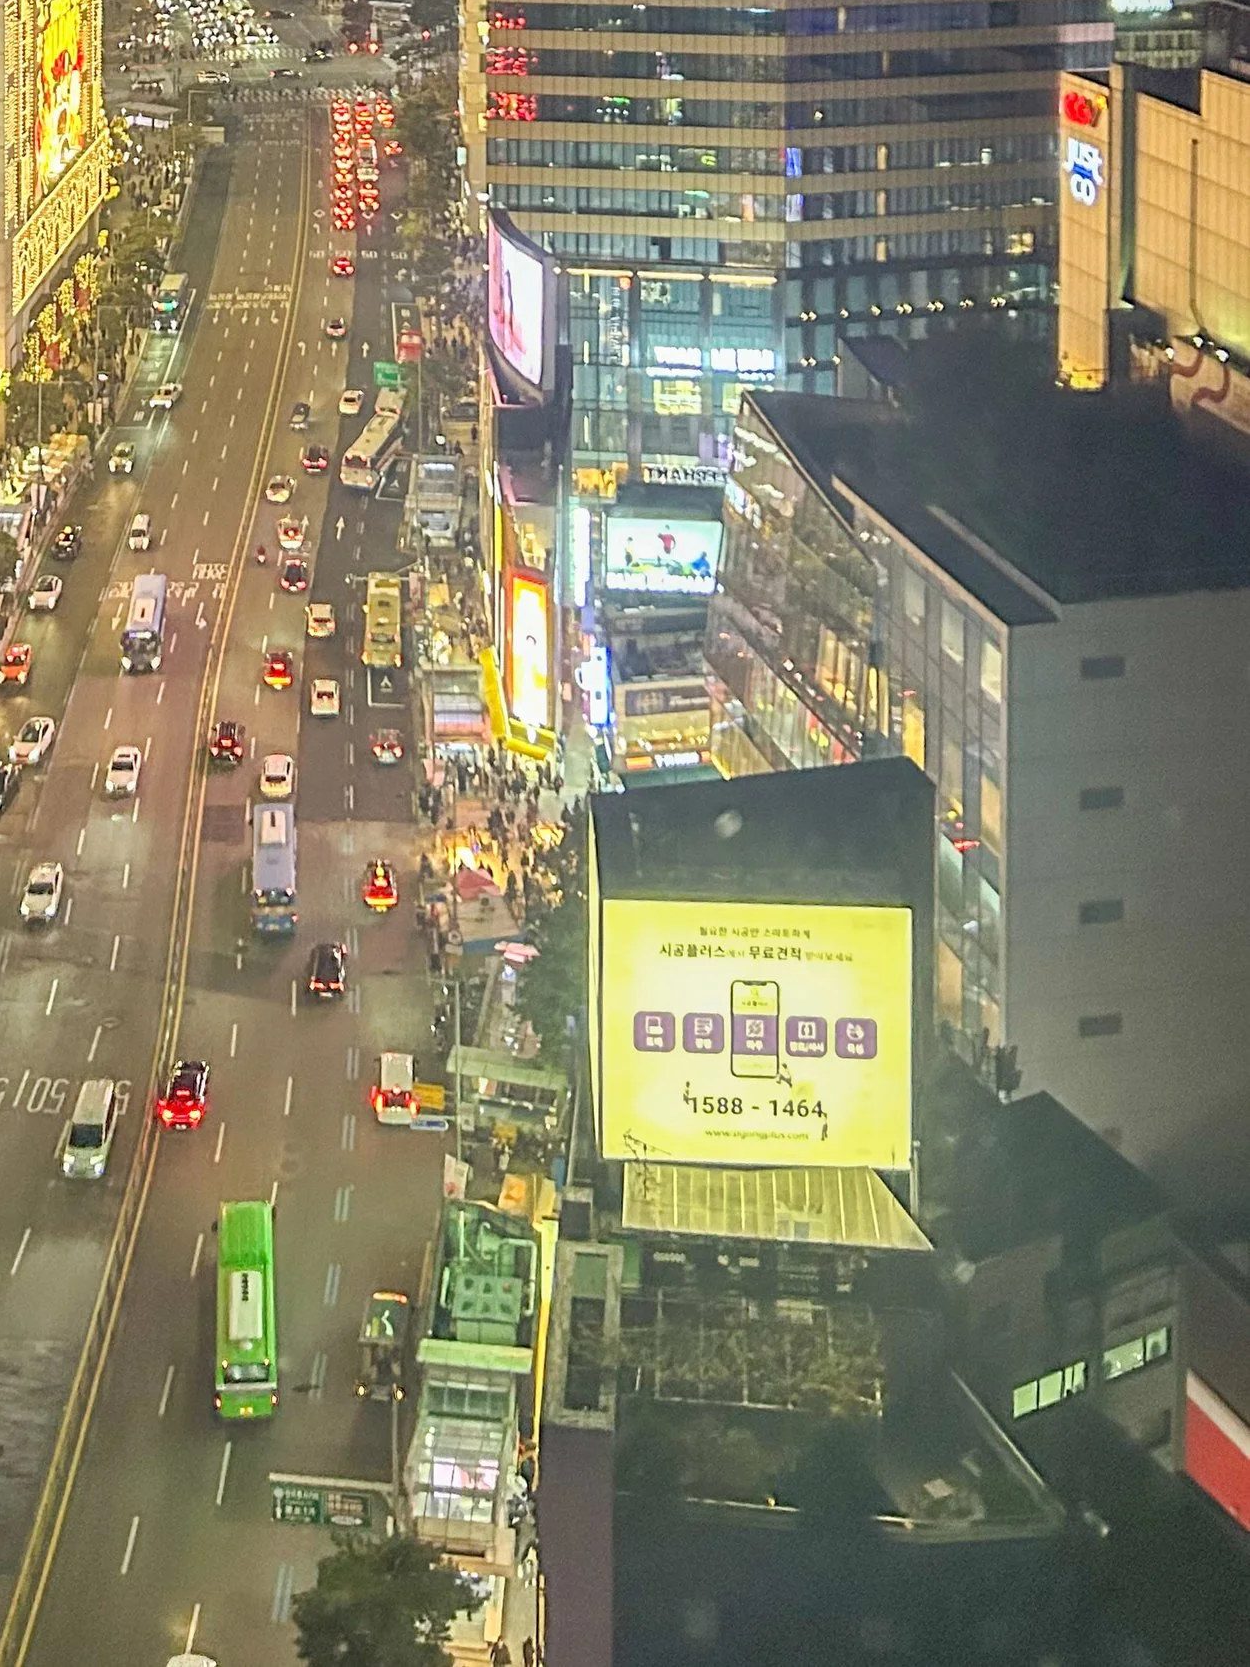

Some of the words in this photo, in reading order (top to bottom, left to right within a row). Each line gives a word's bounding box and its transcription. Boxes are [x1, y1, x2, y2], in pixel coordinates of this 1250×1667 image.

[749, 945, 802, 961] 무료견적
[26, 1077, 70, 1114] 50
[691, 1096, 743, 1115] 1588
[769, 1099, 824, 1118] 1464
